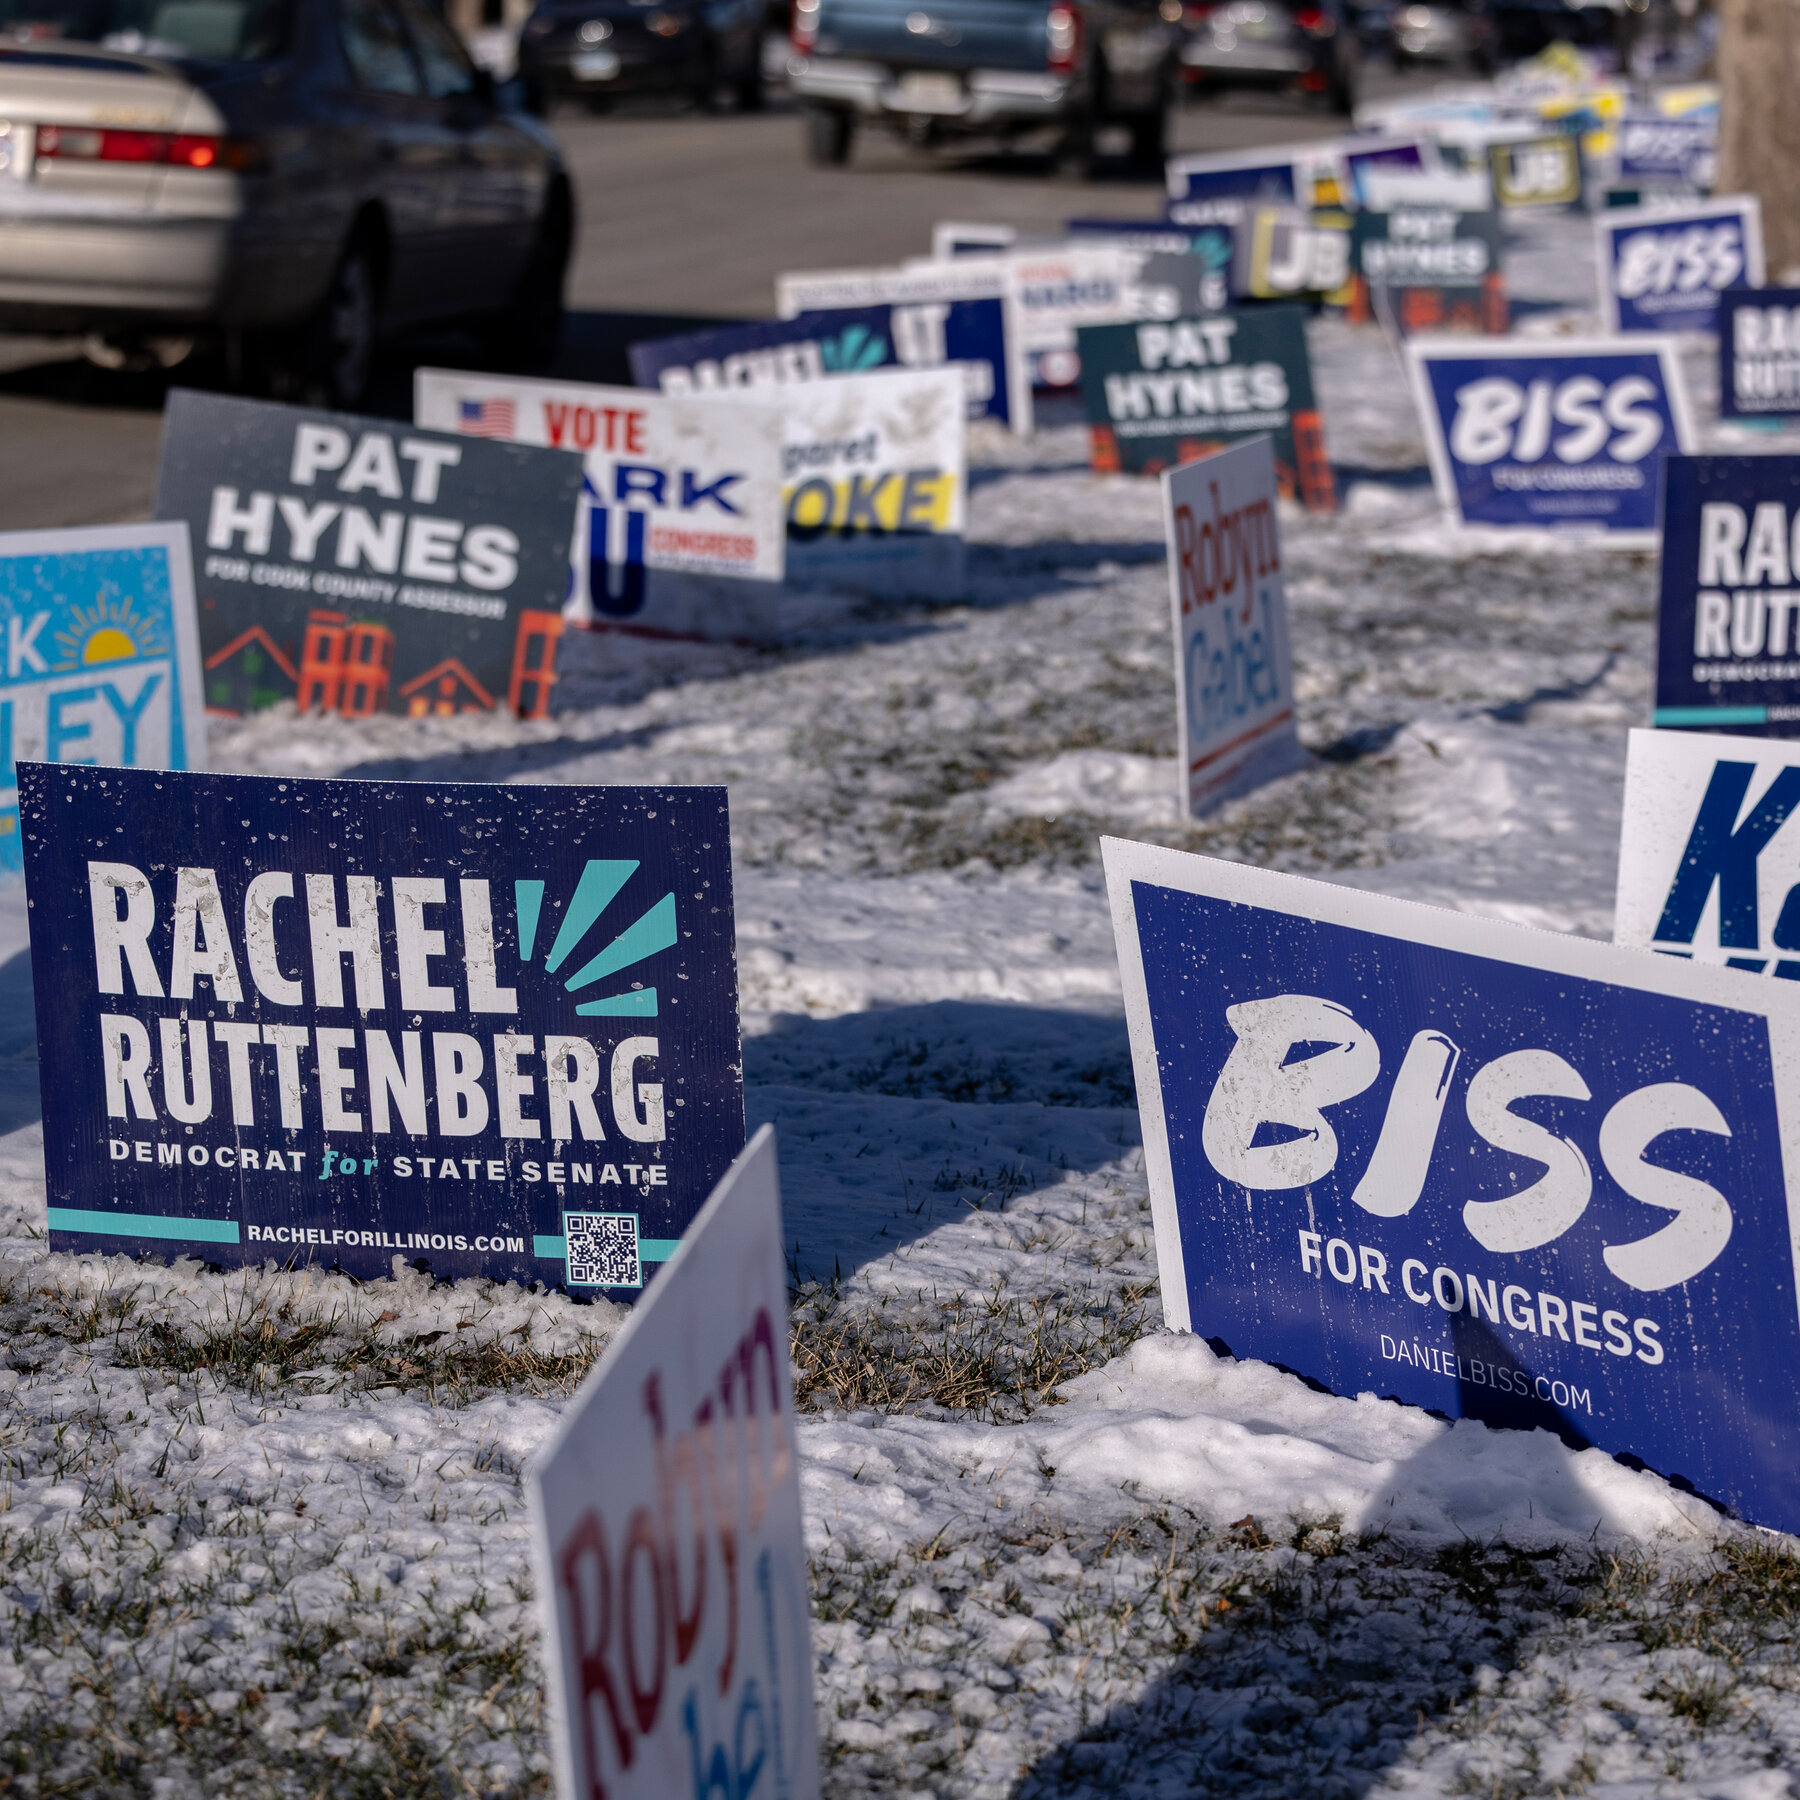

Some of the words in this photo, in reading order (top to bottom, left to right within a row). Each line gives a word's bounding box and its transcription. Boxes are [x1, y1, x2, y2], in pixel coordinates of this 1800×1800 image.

[1507, 151, 1570, 196] JB
[1617, 226, 1743, 298] BISS
[1136, 318, 1237, 370] PAT
[542, 399, 646, 455] VOTE
[1104, 362, 1289, 421] HYNES
[1451, 374, 1664, 465] BISS
[291, 423, 462, 504] PAT
[582, 462, 747, 517] RK
[207, 486, 520, 591] HYNES
[650, 527, 757, 560] CONGRESS
[787, 471, 943, 543] OKE
[1698, 501, 1800, 587] RA
[205, 554, 249, 581] FOR
[251, 561, 311, 592] COOK
[312, 571, 398, 605] COUNTY
[398, 583, 507, 619] ASSESSOR
[1174, 478, 1280, 625] Robyn
[1187, 589, 1278, 742] Gabel
[87, 860, 519, 1015] RACHEL
[101, 1014, 667, 1143] RUTTENBERG
[110, 1138, 307, 1174] DEMOCRAT
[318, 1150, 380, 1181] for
[392, 1155, 506, 1183] STATE
[521, 1160, 669, 1187] SENATE
[1202, 994, 1733, 1292] BISS
[247, 1224, 525, 1255] RACHELFORILLINOIS.COM
[1299, 1229, 1389, 1295] FOR
[1402, 1258, 1664, 1366] CONGRESS
[1380, 1333, 1593, 1414] DANIELBISS.COM
